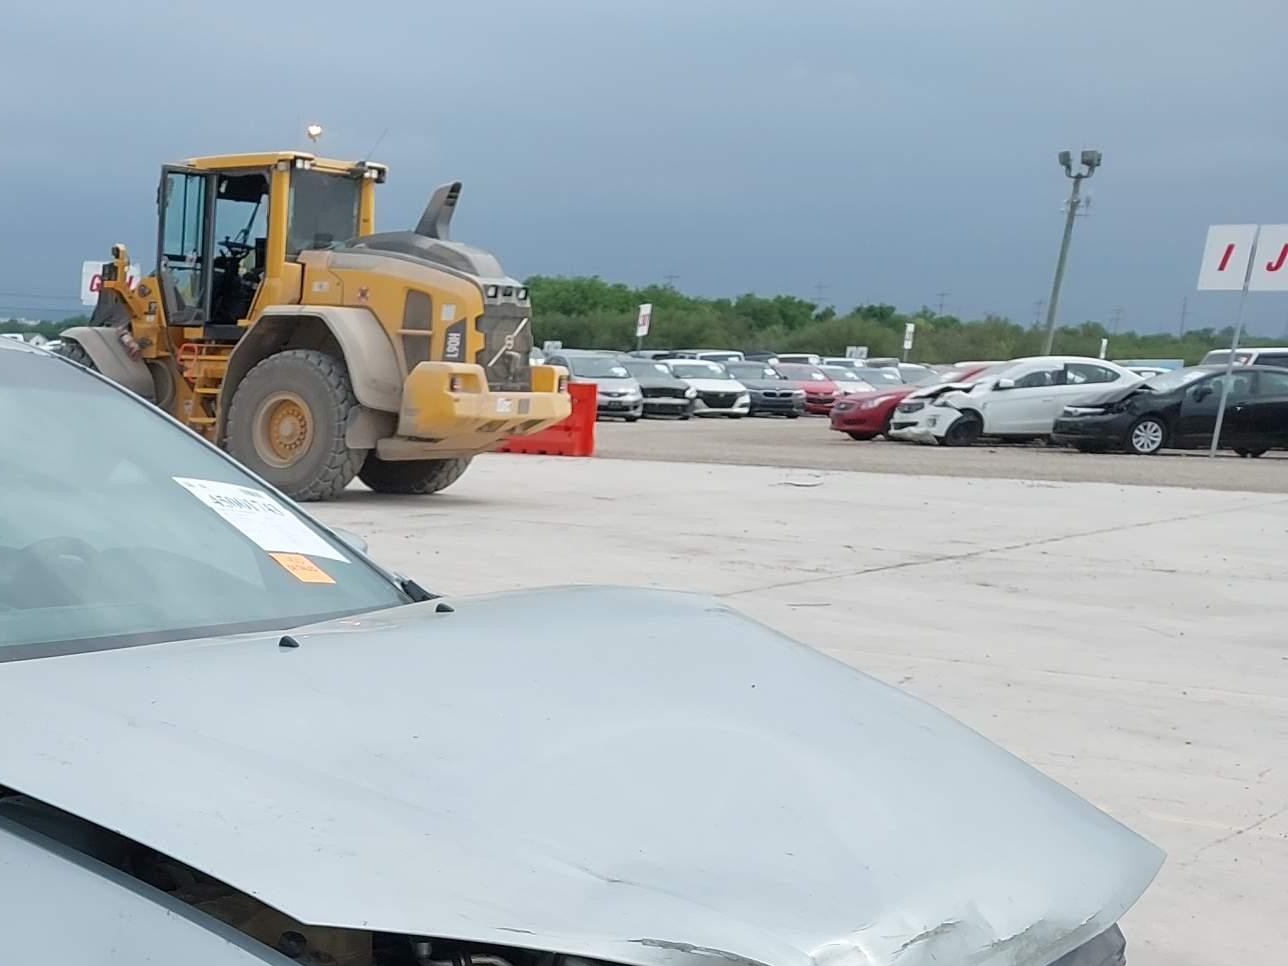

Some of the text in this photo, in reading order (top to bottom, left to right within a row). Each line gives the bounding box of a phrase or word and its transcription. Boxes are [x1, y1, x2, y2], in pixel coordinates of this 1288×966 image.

[1217, 243, 1235, 271] I
[1266, 243, 1288, 272] J
[445, 332, 461, 358] L90H
